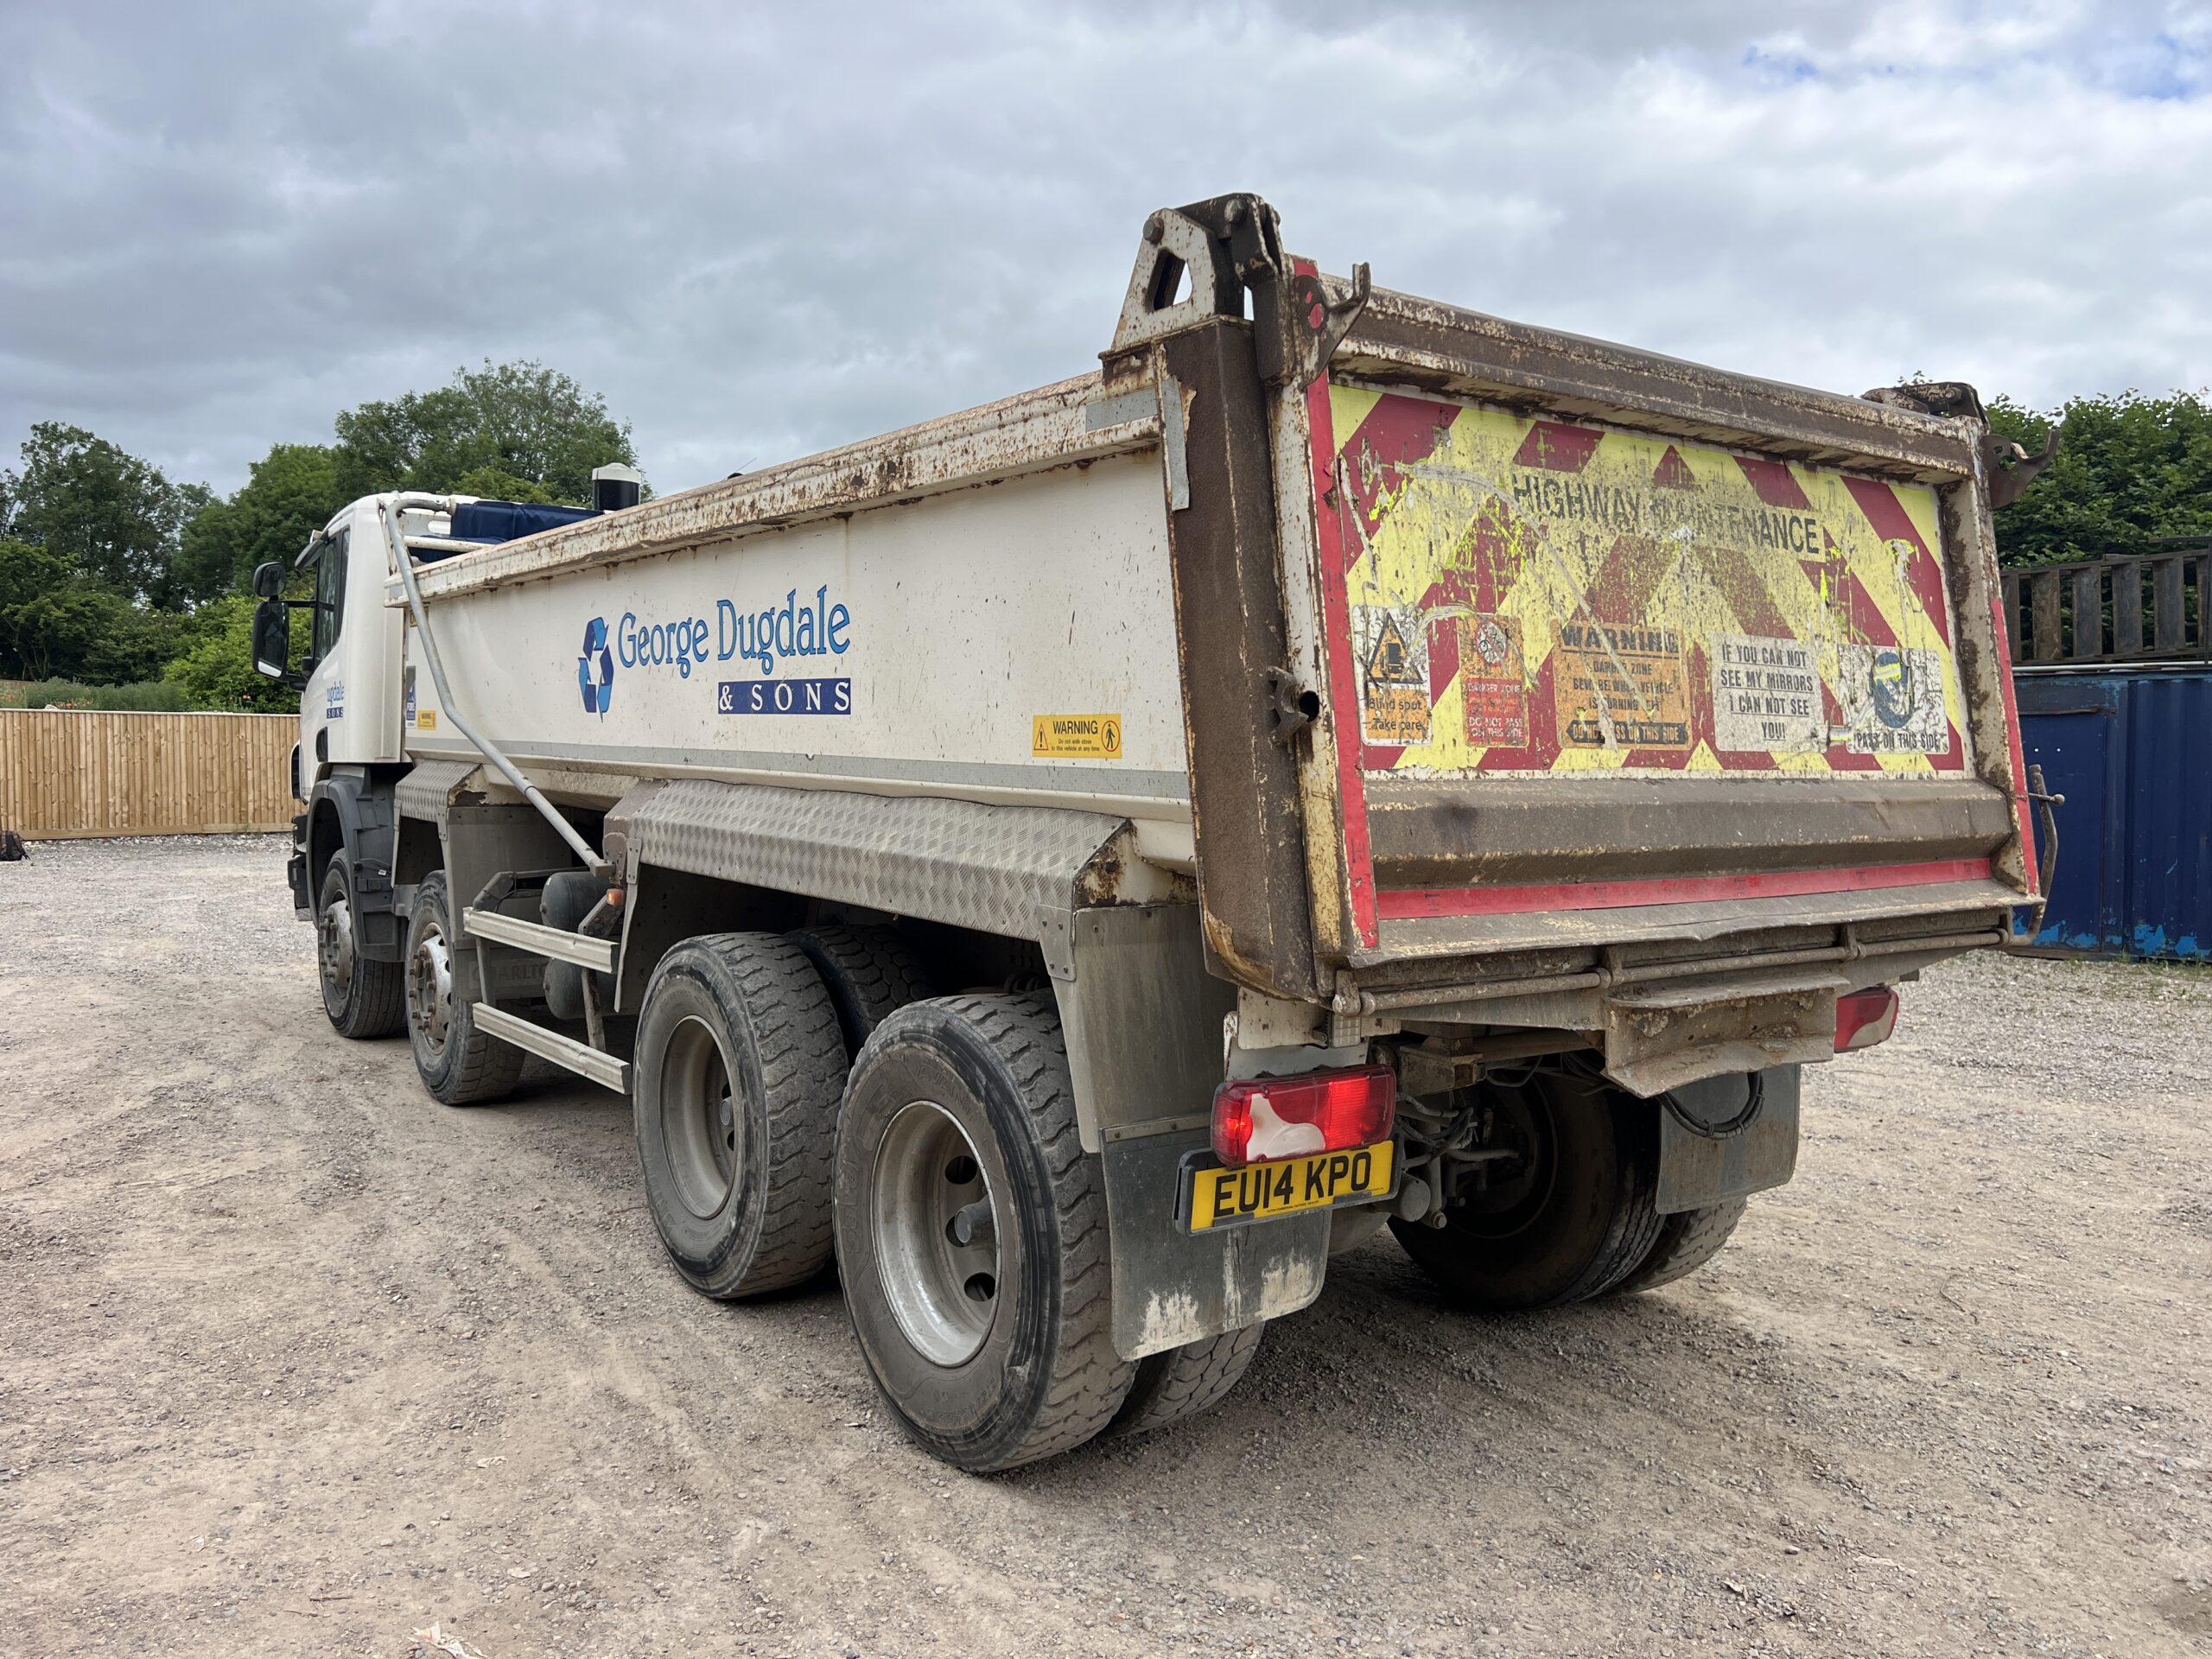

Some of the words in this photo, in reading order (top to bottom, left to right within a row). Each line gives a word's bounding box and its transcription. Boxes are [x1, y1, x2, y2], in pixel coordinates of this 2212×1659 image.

[1513, 474, 1640, 527] HIGHWAY
[618, 612, 709, 679] George
[717, 584, 851, 676] Dugdale
[1561, 626, 1680, 653] WARNING
[1722, 645, 1732, 661] IF
[1737, 645, 1758, 663] YOU
[1762, 648, 1783, 664] CAN
[1787, 650, 1807, 667] NOT
[1720, 670, 1741, 686] SEE
[1745, 671, 1762, 688] MY
[1766, 672, 1814, 691] MIRRORS
[719, 684, 734, 711] &
[751, 682, 850, 711] SONS
[1369, 697, 1395, 709] Blind
[1399, 699, 1422, 713] spot
[1605, 697, 1638, 710] URNING
[1730, 695, 1734, 711] I
[1738, 695, 1761, 713] CAN
[1765, 696, 1786, 714] NOT
[1790, 699, 1809, 715] SEE
[1052, 720, 1098, 734] WARNING
[1372, 718, 1396, 730] Take
[1400, 721, 1421, 731] care
[1469, 717, 1482, 727] DO
[1762, 722, 1786, 739] YOU!
[1487, 728, 1503, 737] THIS
[1573, 724, 1585, 739] DO
[1642, 726, 1659, 741] THIS
[1856, 733, 1880, 749] PASS
[1884, 733, 1895, 748] ON
[1898, 733, 1917, 748] THIS
[1921, 733, 1939, 748] SIDE
[1213, 1165, 1294, 1217] EU14
[1305, 1151, 1371, 1200] KPO
